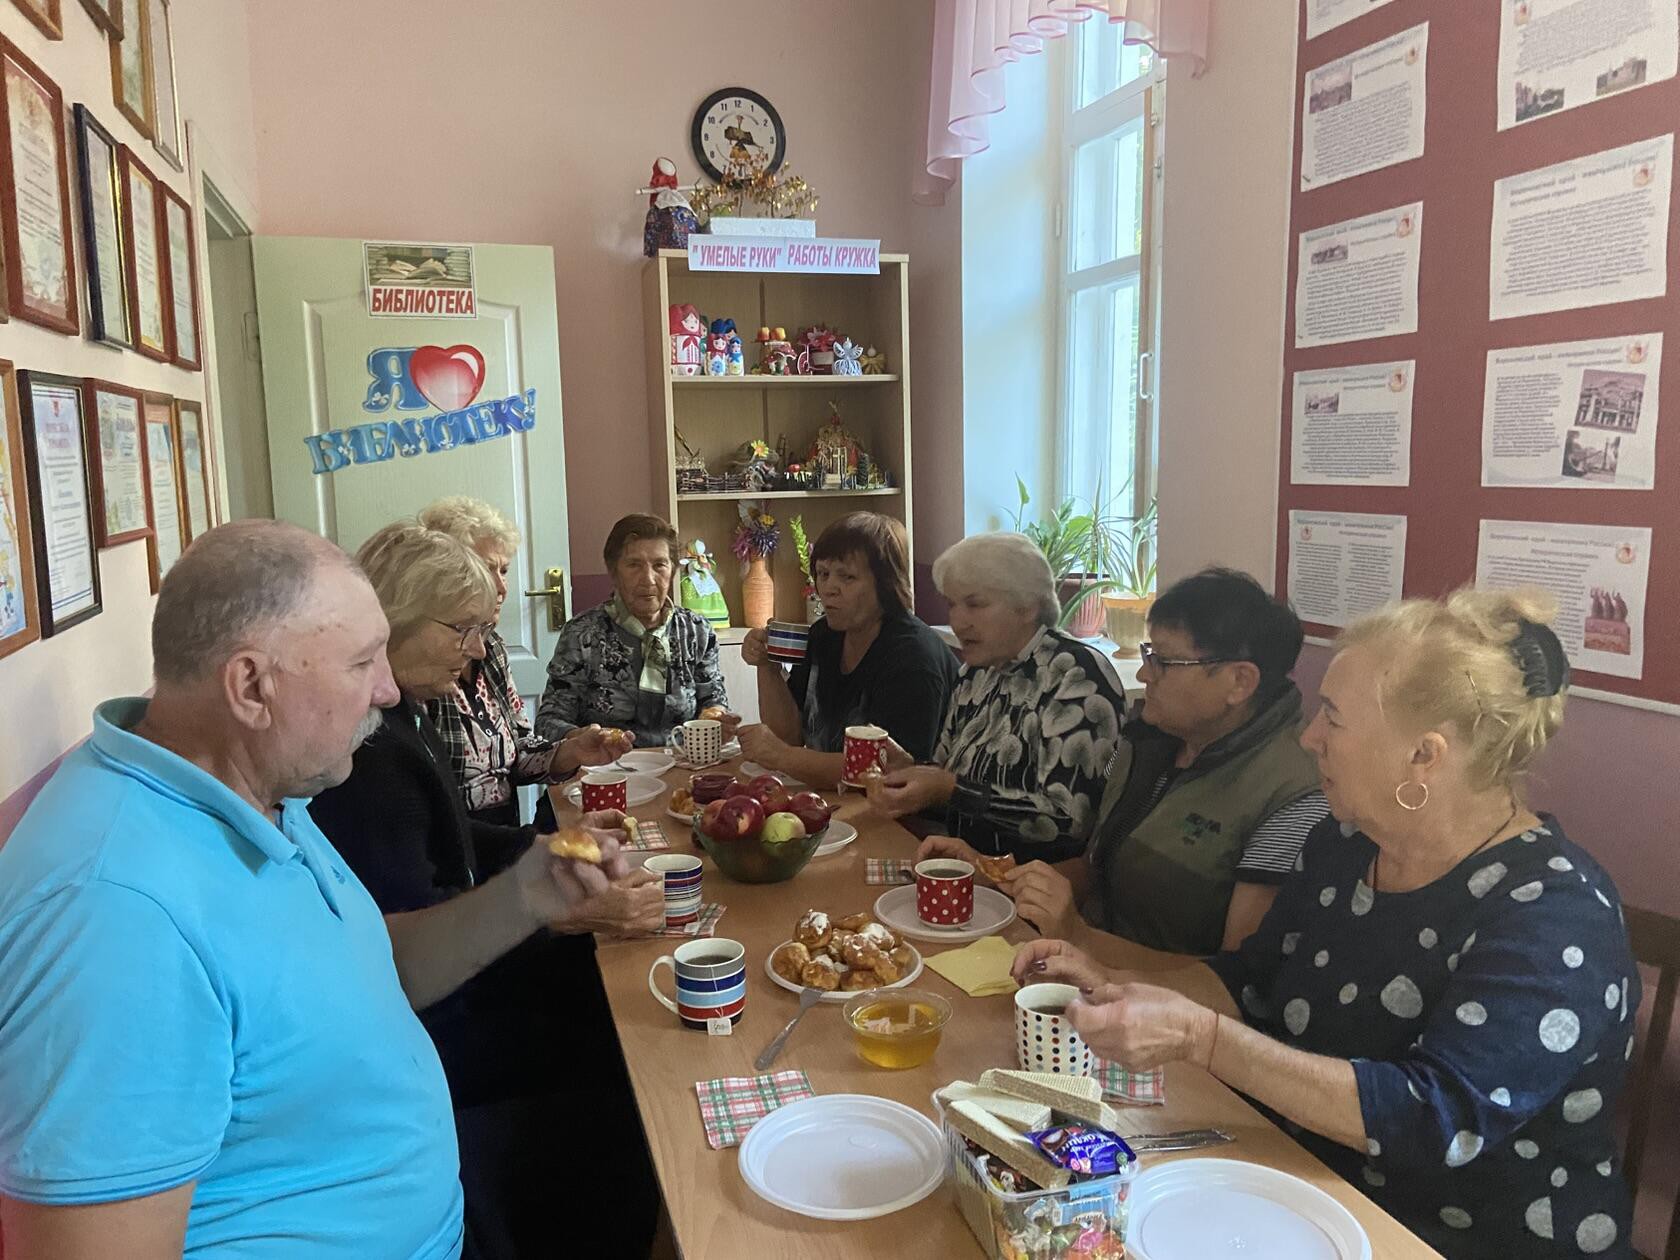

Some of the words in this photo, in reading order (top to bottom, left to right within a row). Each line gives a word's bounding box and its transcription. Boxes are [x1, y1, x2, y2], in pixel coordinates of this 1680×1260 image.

[721, 103, 728, 111] 11
[734, 100, 742, 108] 12
[708, 116, 716, 124] 10
[750, 246, 782, 268] РУКИ"
[787, 244, 832, 266] РАБОТЫ
[834, 246, 877, 268] КРУЖКА
[371, 288, 474, 314] БИБЛИОТЕКА
[362, 347, 430, 413] Я
